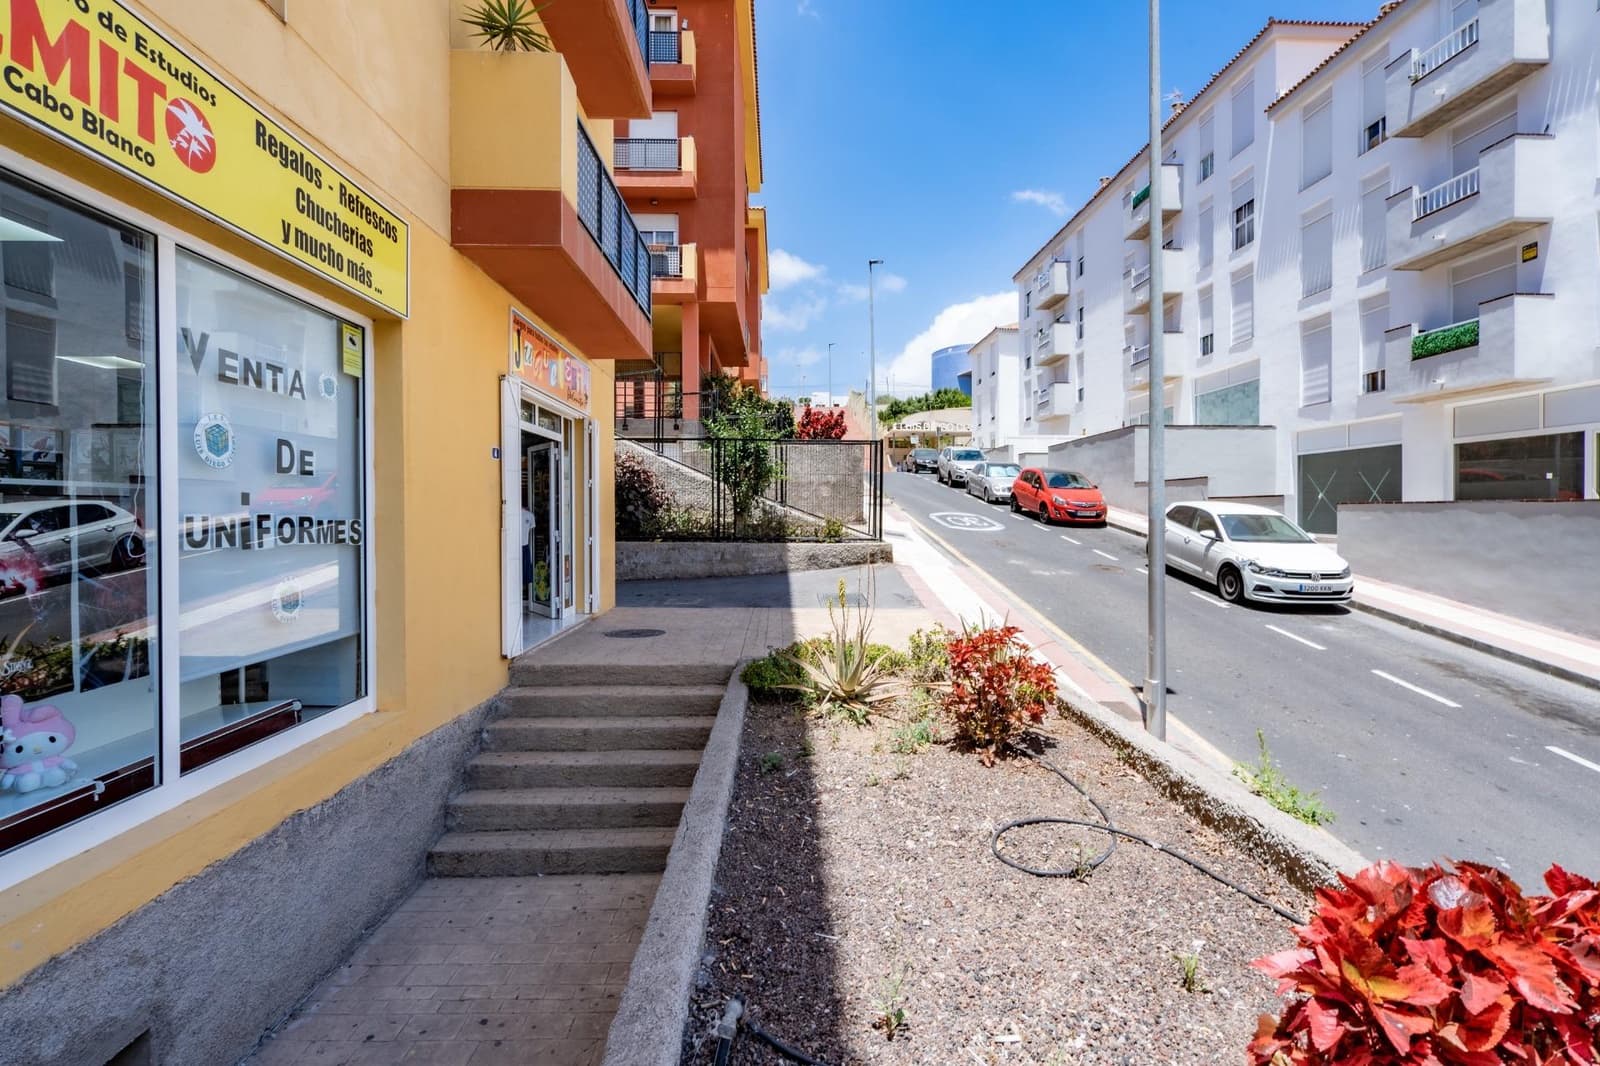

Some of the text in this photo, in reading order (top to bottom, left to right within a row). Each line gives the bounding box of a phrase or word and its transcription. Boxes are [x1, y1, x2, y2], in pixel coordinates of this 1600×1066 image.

[97, 11, 128, 43] de
[134, 32, 217, 107] Estudios
[3, 65, 156, 167] Cabo Blanco
[255, 118, 323, 190] Regalos
[339, 182, 398, 244] Refrescos
[281, 219, 291, 245] y
[294, 226, 345, 272] mucho
[181, 327, 306, 400] VENTA
[276, 437, 315, 477] DE
